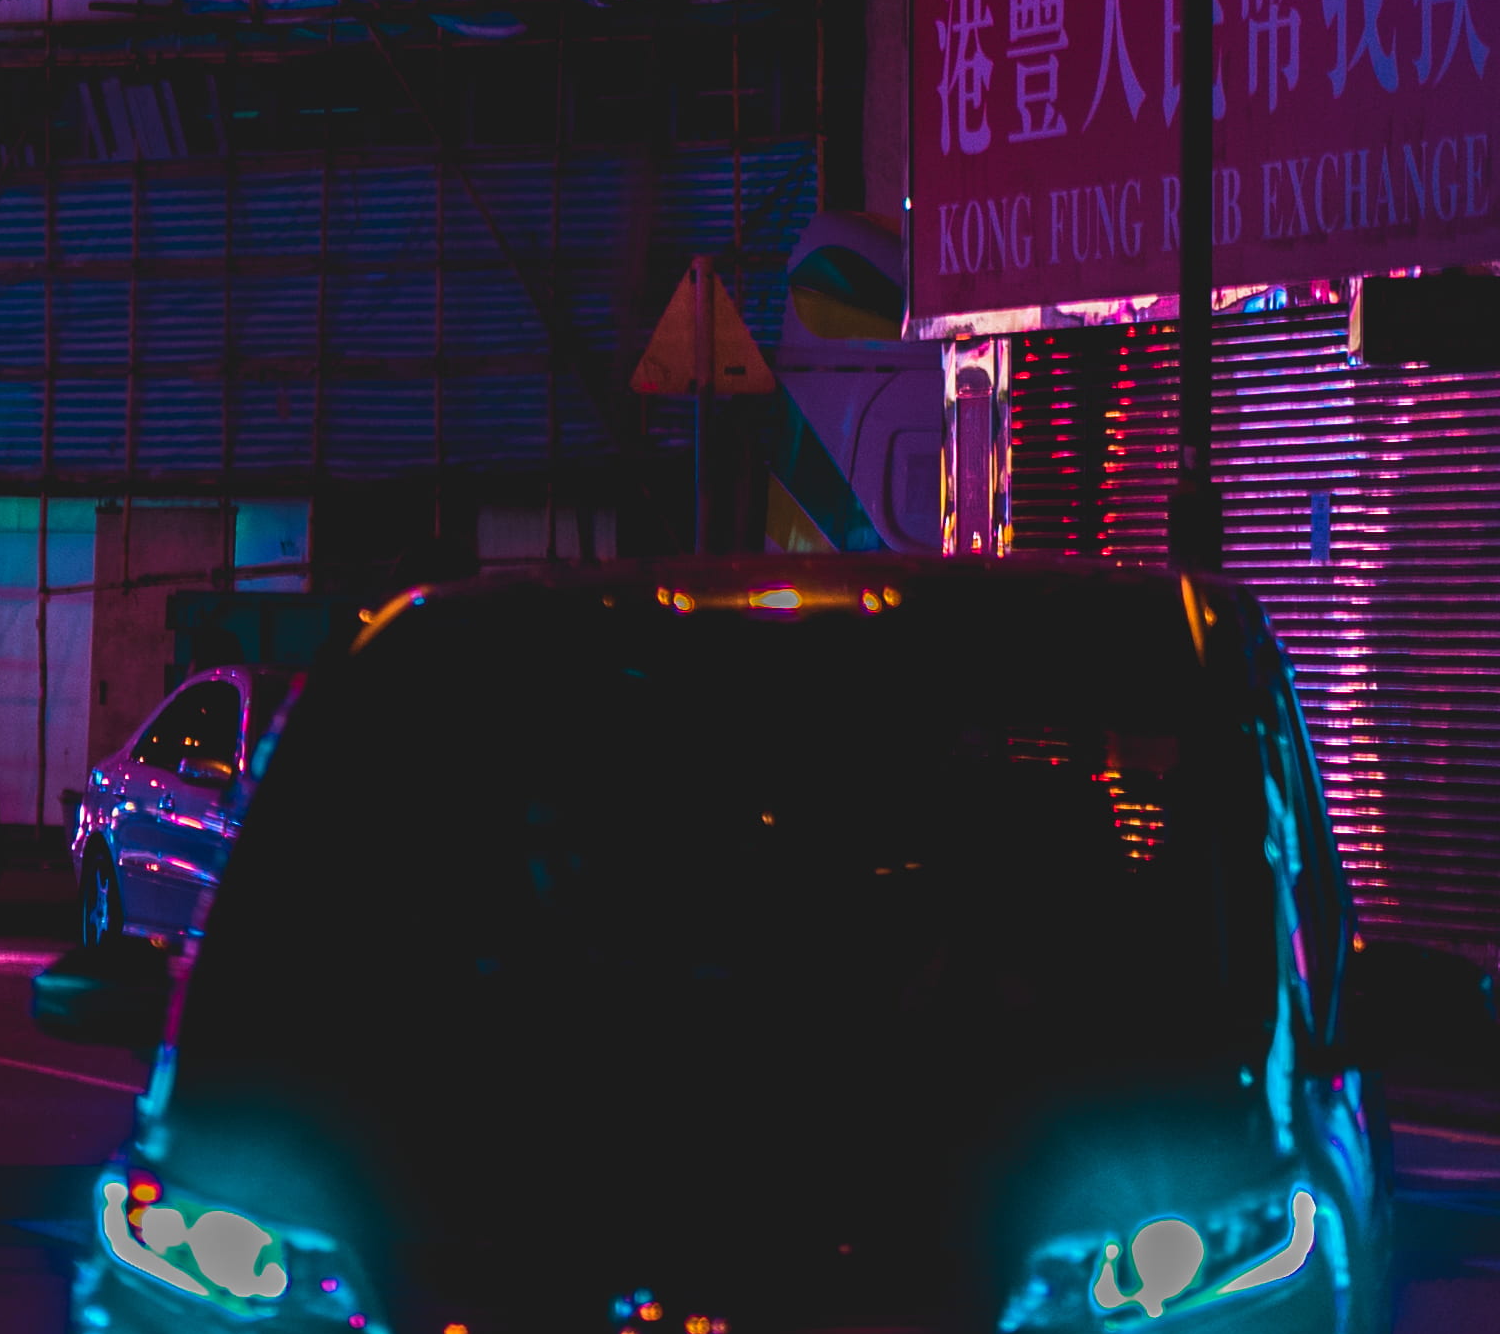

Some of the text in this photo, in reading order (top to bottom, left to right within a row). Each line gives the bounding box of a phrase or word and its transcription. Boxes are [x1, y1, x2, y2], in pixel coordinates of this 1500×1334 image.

[938, 133, 1490, 275] KONG FUNG RB EXCHANGE
